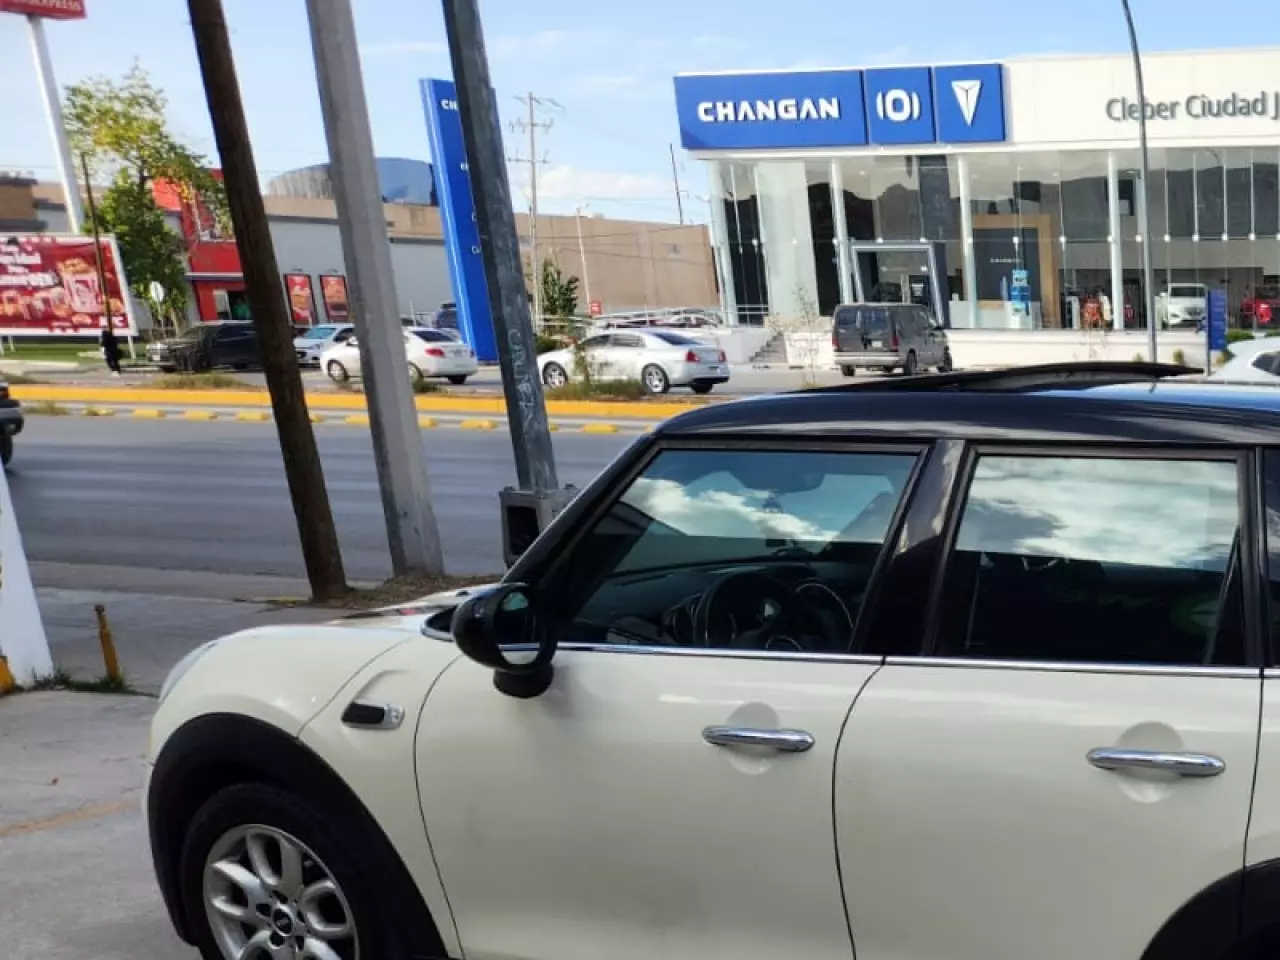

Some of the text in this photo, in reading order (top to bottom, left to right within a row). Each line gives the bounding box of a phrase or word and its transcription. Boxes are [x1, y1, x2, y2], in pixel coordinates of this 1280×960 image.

[697, 97, 841, 122] CHANGAN
[1105, 97, 1179, 122] Cleber
[1185, 92, 1267, 119] Ciudad
